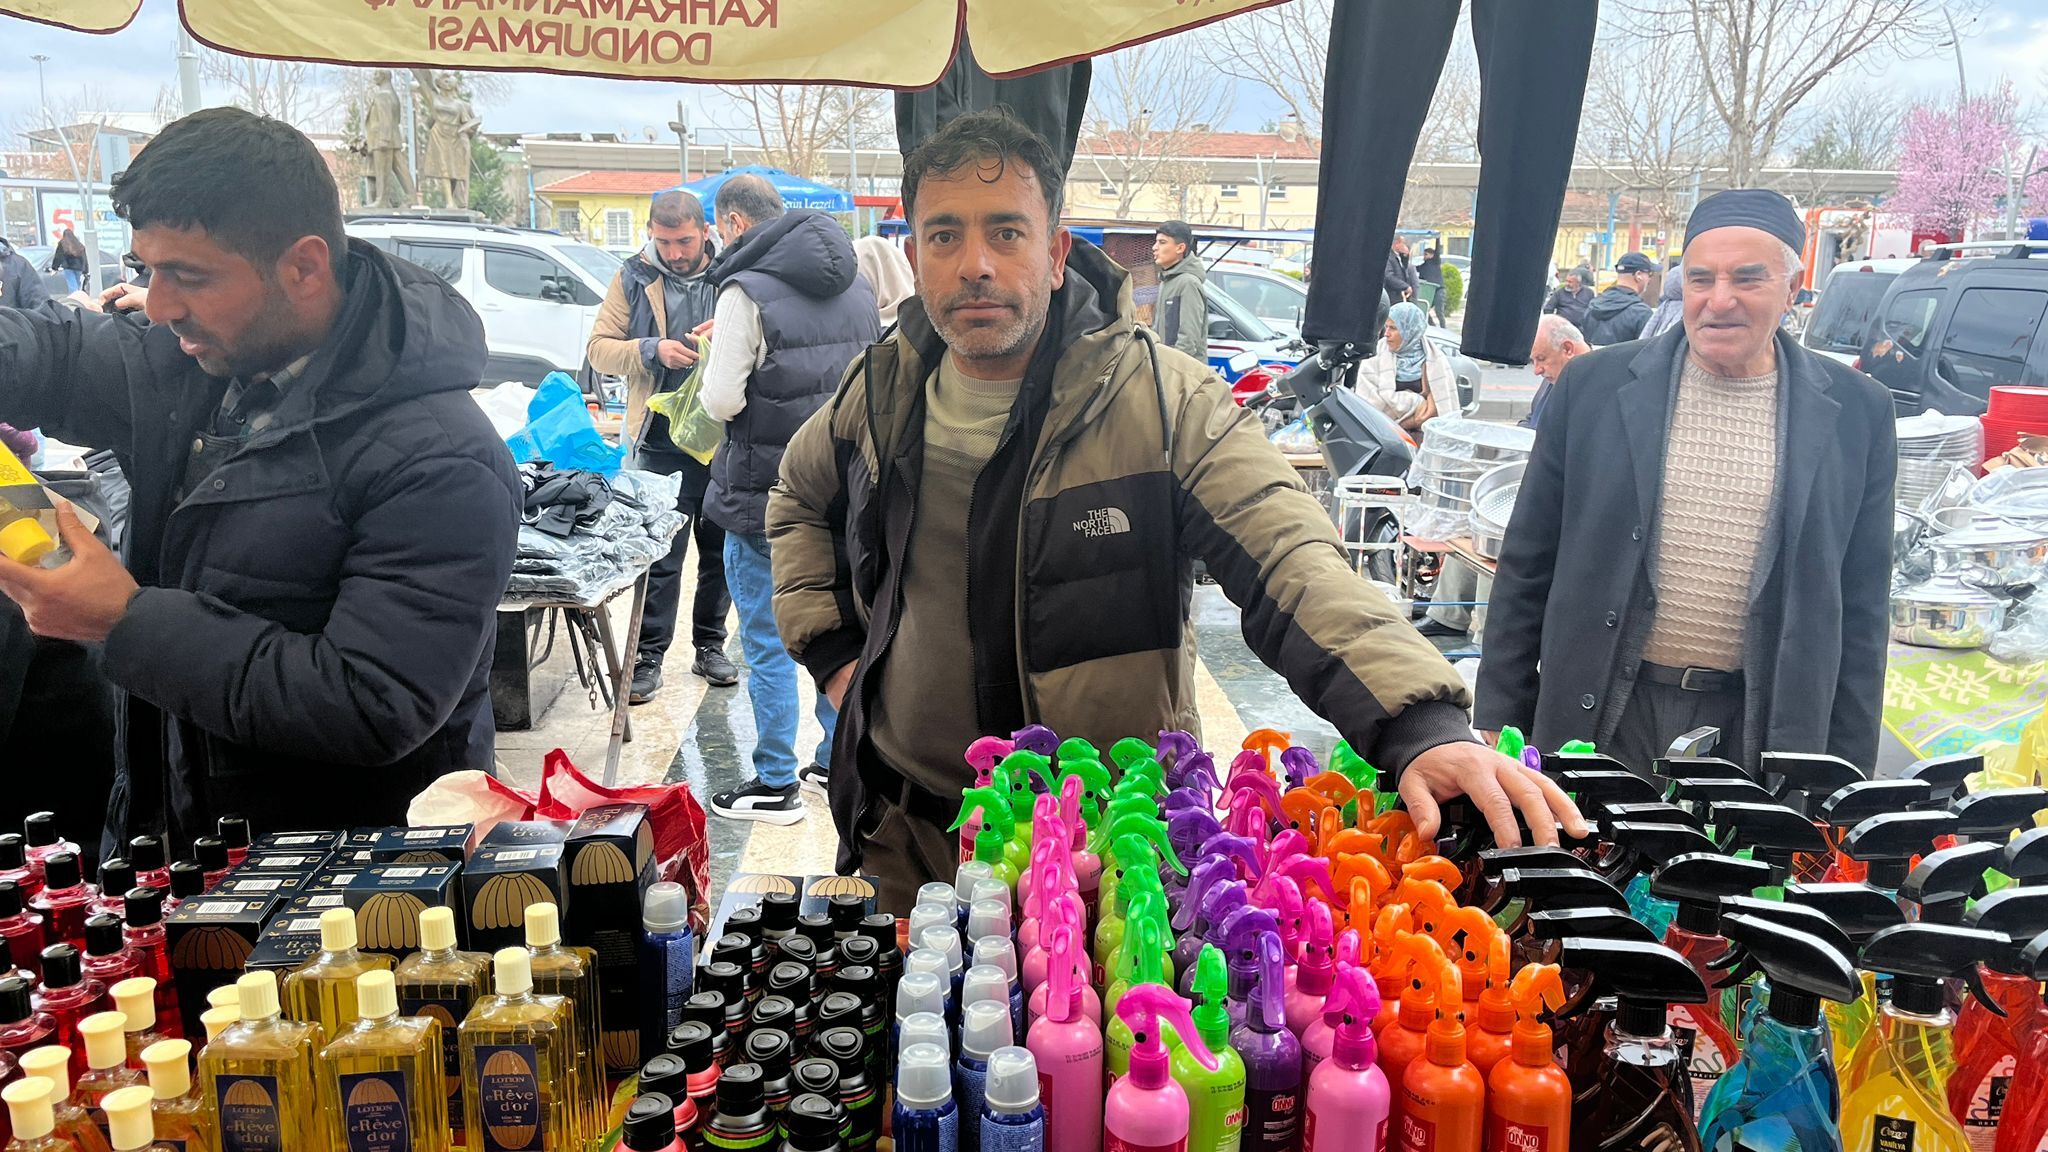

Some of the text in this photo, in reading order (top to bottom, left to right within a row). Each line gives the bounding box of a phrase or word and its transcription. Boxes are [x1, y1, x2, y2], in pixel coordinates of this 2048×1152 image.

[1087, 507, 1108, 520] THE
[1072, 516, 1109, 532] NORTH
[1084, 525, 1111, 538] FACE
[492, 1076, 525, 1084] LOTION
[357, 1104, 393, 1114] LOTION
[1507, 1131, 1539, 1149] ONNO
